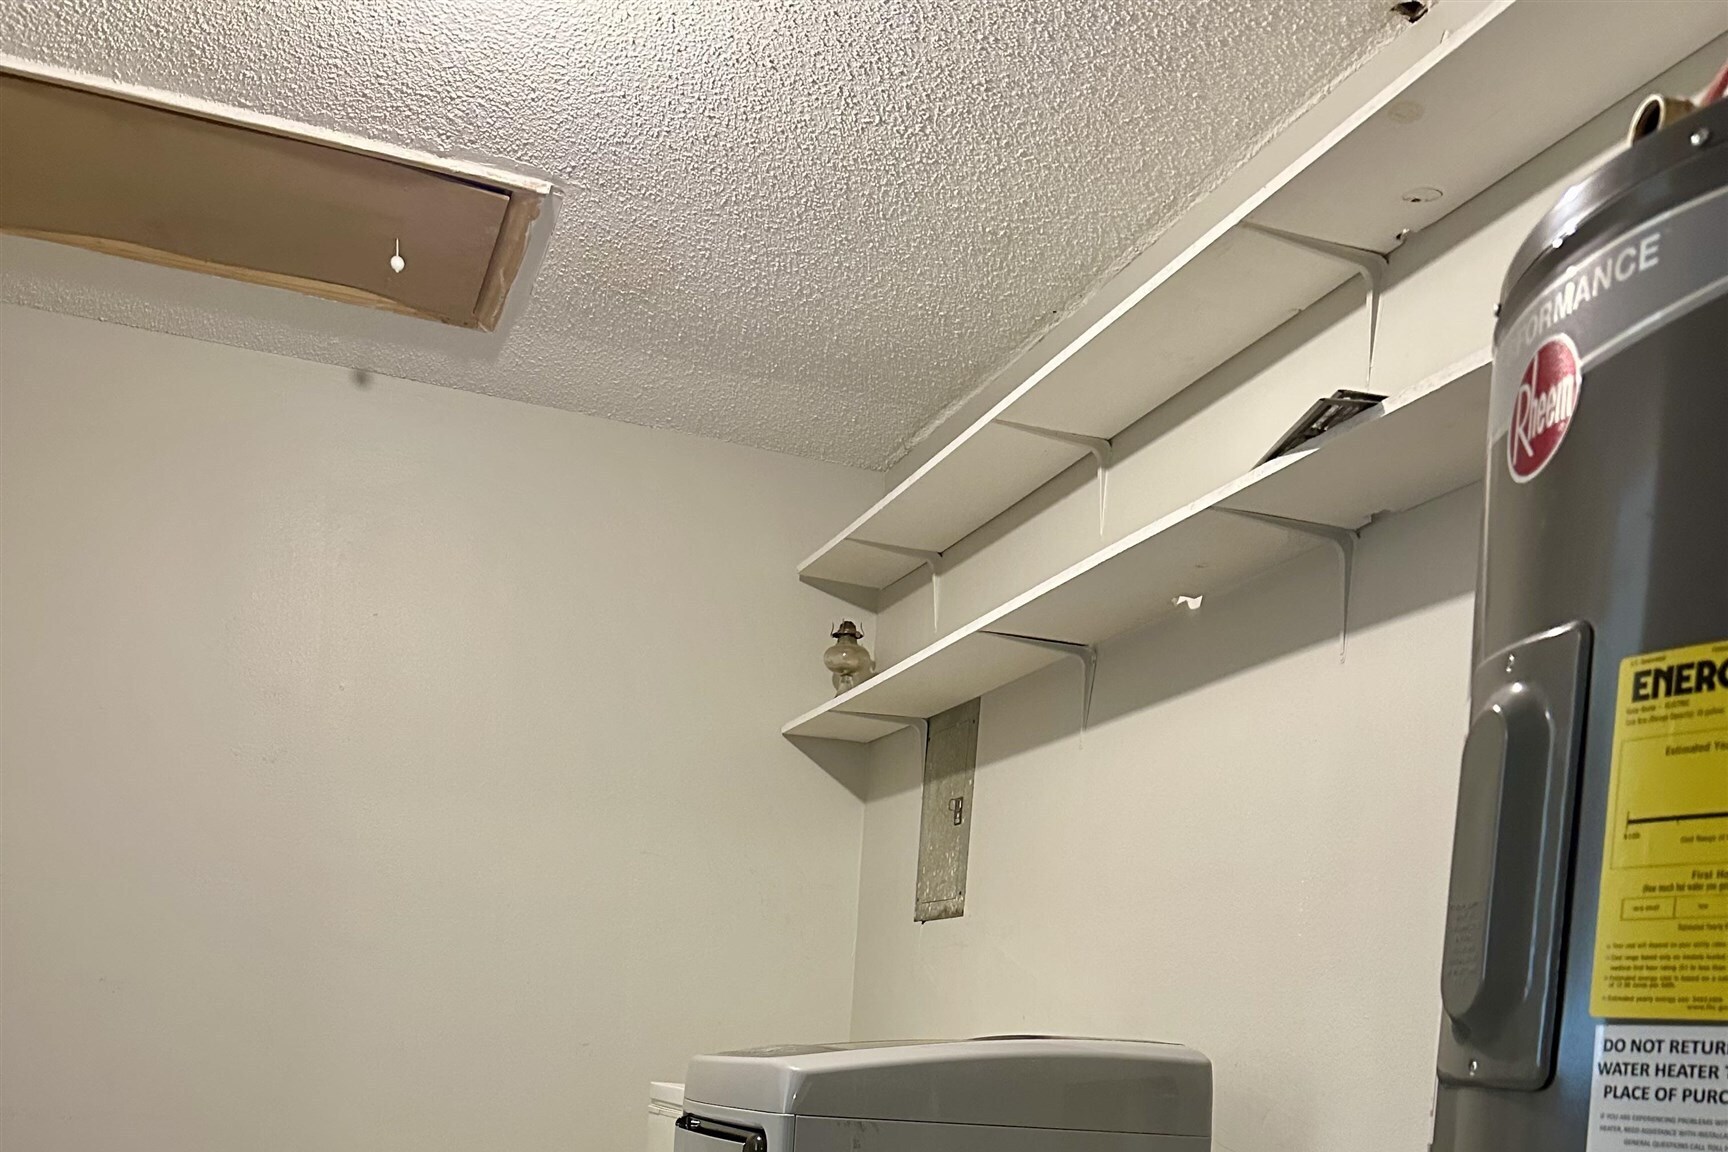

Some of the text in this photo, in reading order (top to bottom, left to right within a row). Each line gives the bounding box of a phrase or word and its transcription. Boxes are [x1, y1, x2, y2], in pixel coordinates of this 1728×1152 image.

[1512, 353, 1574, 467] Rheem
[1604, 1038, 1728, 1056] DO NOT RETUR
[1598, 1062, 1650, 1078] WATER
[1655, 1063, 1719, 1079] HEATER
[1603, 1085, 1728, 1105] PLACE OF PURC
